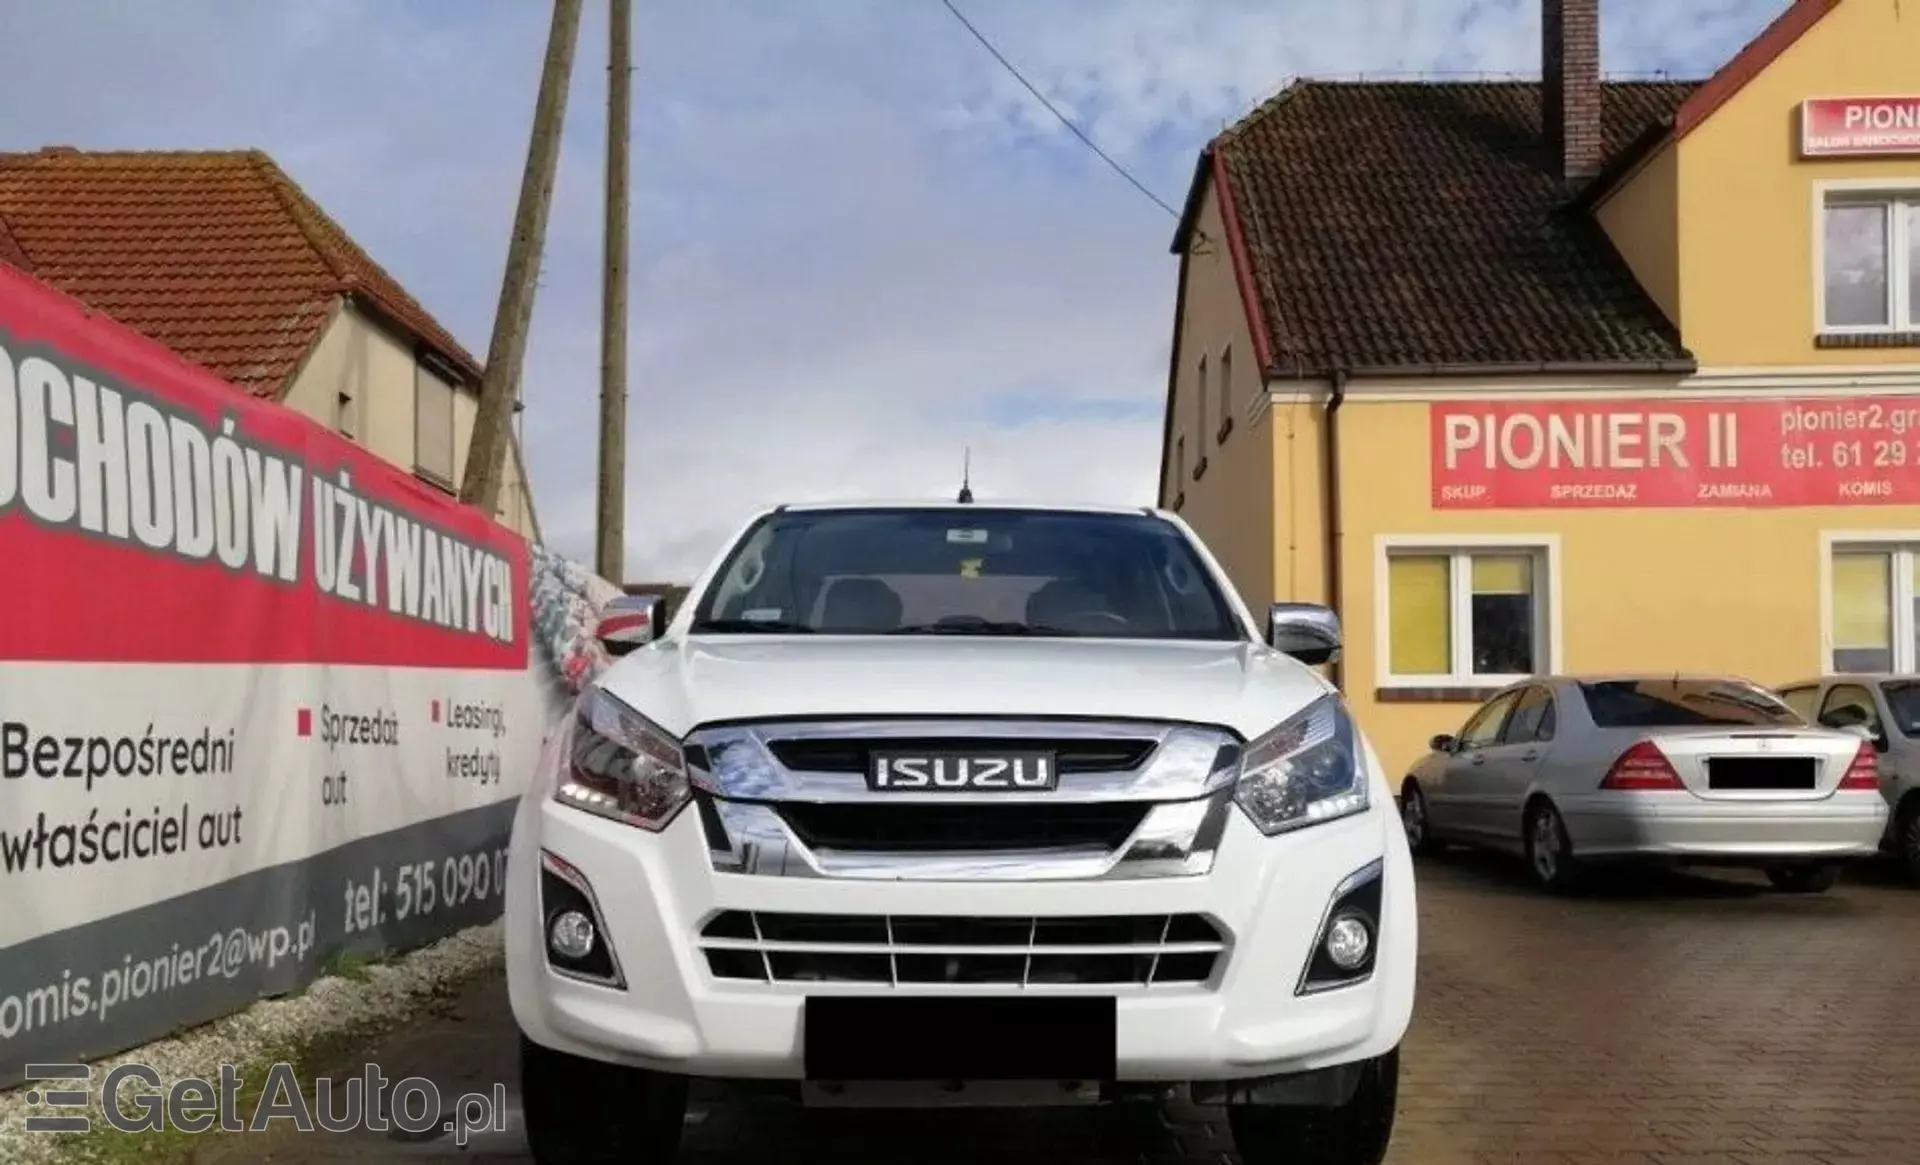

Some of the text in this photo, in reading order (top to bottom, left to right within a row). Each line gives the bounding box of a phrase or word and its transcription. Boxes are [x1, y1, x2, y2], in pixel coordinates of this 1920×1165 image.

[1444, 403, 1920, 470] PIONIER II pionier2.gr
[1781, 442, 1823, 469] tel.
[1832, 440, 1862, 468] 61
[1873, 440, 1906, 466] 29
[1441, 484, 1487, 501] SKUP
[1697, 483, 1772, 499] ZAMIANA
[1838, 480, 1893, 497] KOMIS
[313, 470, 513, 642] UŻYWANYCH
[320, 703, 399, 751] Sprzedaż
[1, 722, 235, 792] Bezpośredni
[446, 746, 500, 785] kredyty
[877, 758, 1048, 787] ISUZU
[322, 771, 348, 806] aut
[0, 802, 243, 874] właściciel aut
[343, 866, 388, 935] tel:
[395, 860, 436, 921] 515
[442, 852, 490, 908] 090
[0, 909, 317, 1039] omis.pionier2@wp.pl
